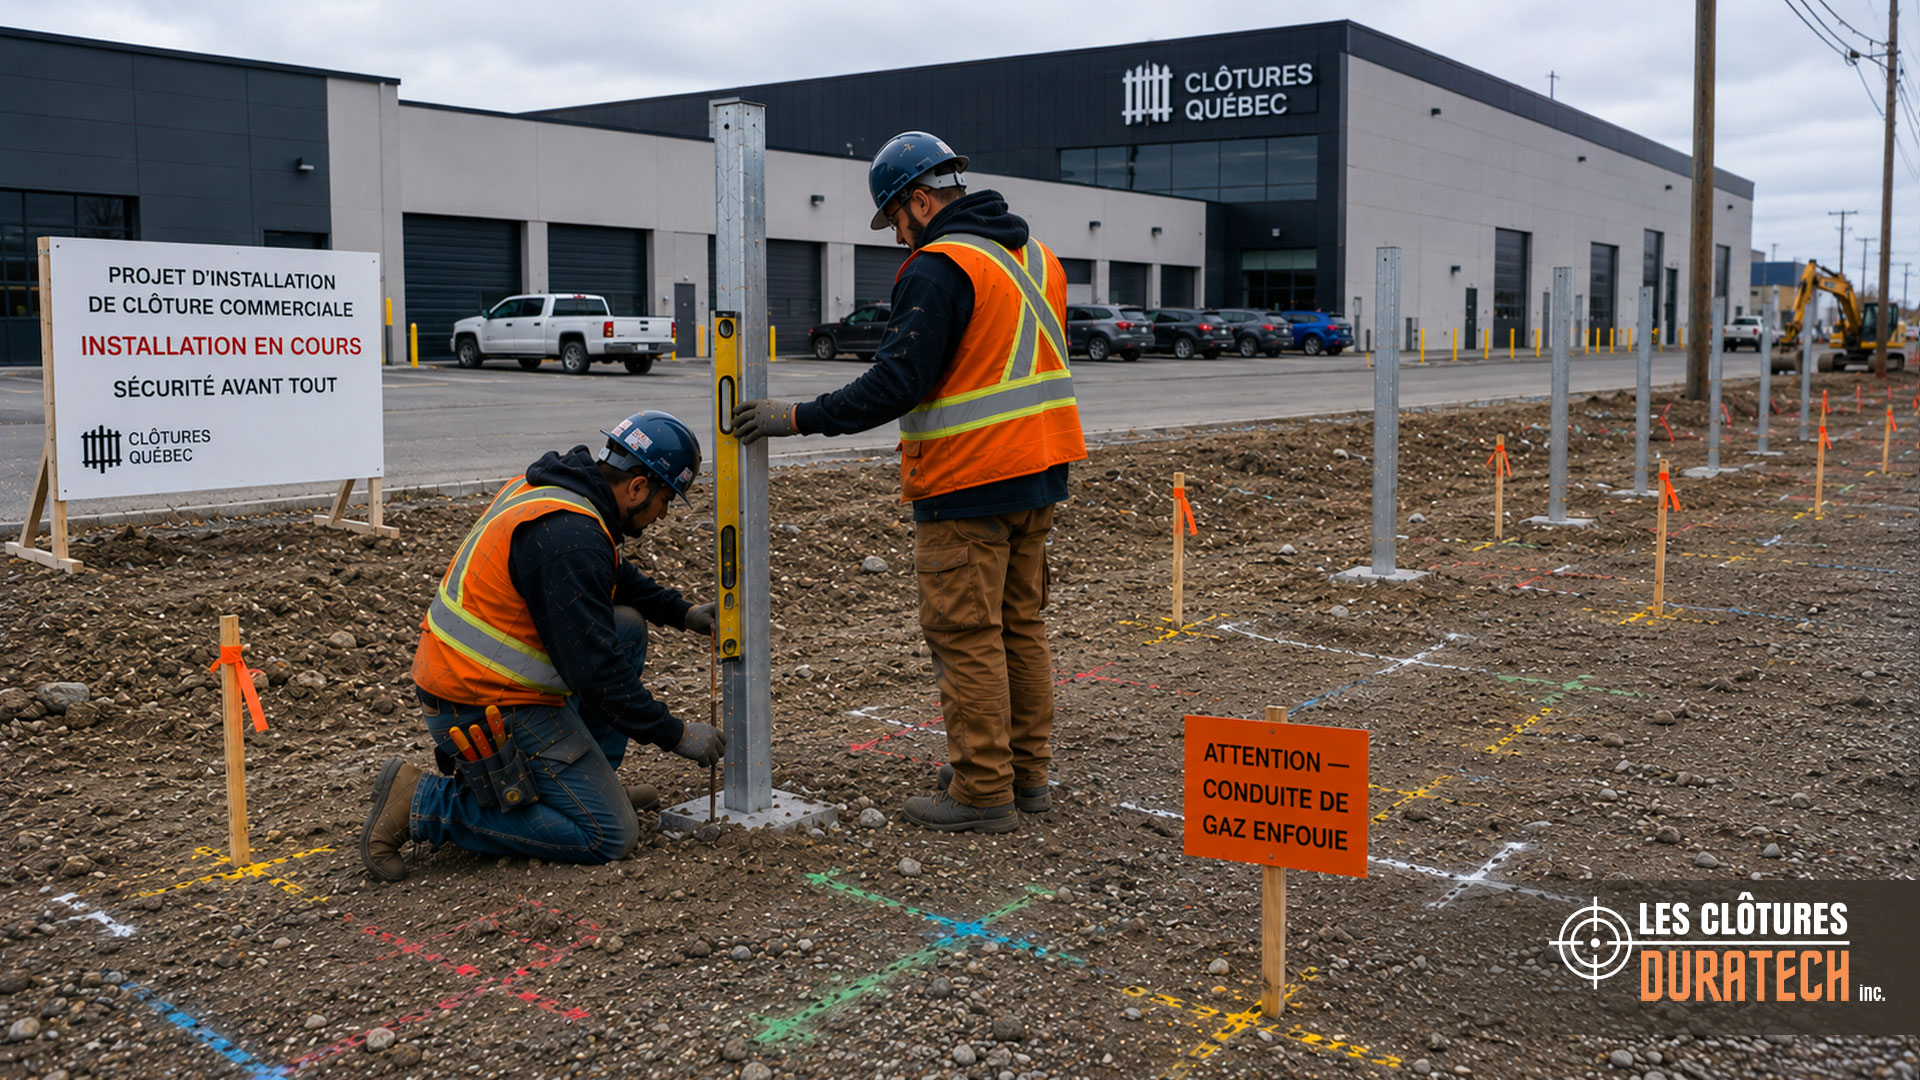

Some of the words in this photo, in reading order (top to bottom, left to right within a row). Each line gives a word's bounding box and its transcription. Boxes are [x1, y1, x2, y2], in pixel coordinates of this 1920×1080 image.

[1185, 63, 1313, 93] CLÔTURES
[1185, 92, 1288, 121] QUÉBEC
[108, 266, 187, 286] PROJET
[192, 269, 336, 290] D’INSTALLATION
[88, 296, 116, 314] DE
[122, 293, 214, 315] CLÔTURE
[219, 299, 354, 318] COMMERCIALE
[81, 335, 247, 356] INSTALLATION
[254, 337, 284, 356] EN
[290, 337, 362, 355] COURS
[113, 374, 215, 398] SÉCURITÉ
[221, 378, 284, 396] AVANT
[288, 377, 338, 393] TOUT
[128, 428, 211, 446] CLÔTURES
[128, 446, 193, 465] QUÉBEC
[1203, 742, 1321, 773] ATTENTION
[1203, 778, 1312, 809] CONDUITE
[1320, 791, 1349, 813] DE
[1202, 814, 1246, 839] GAZ
[1253, 820, 1348, 851] ENFOUIE
